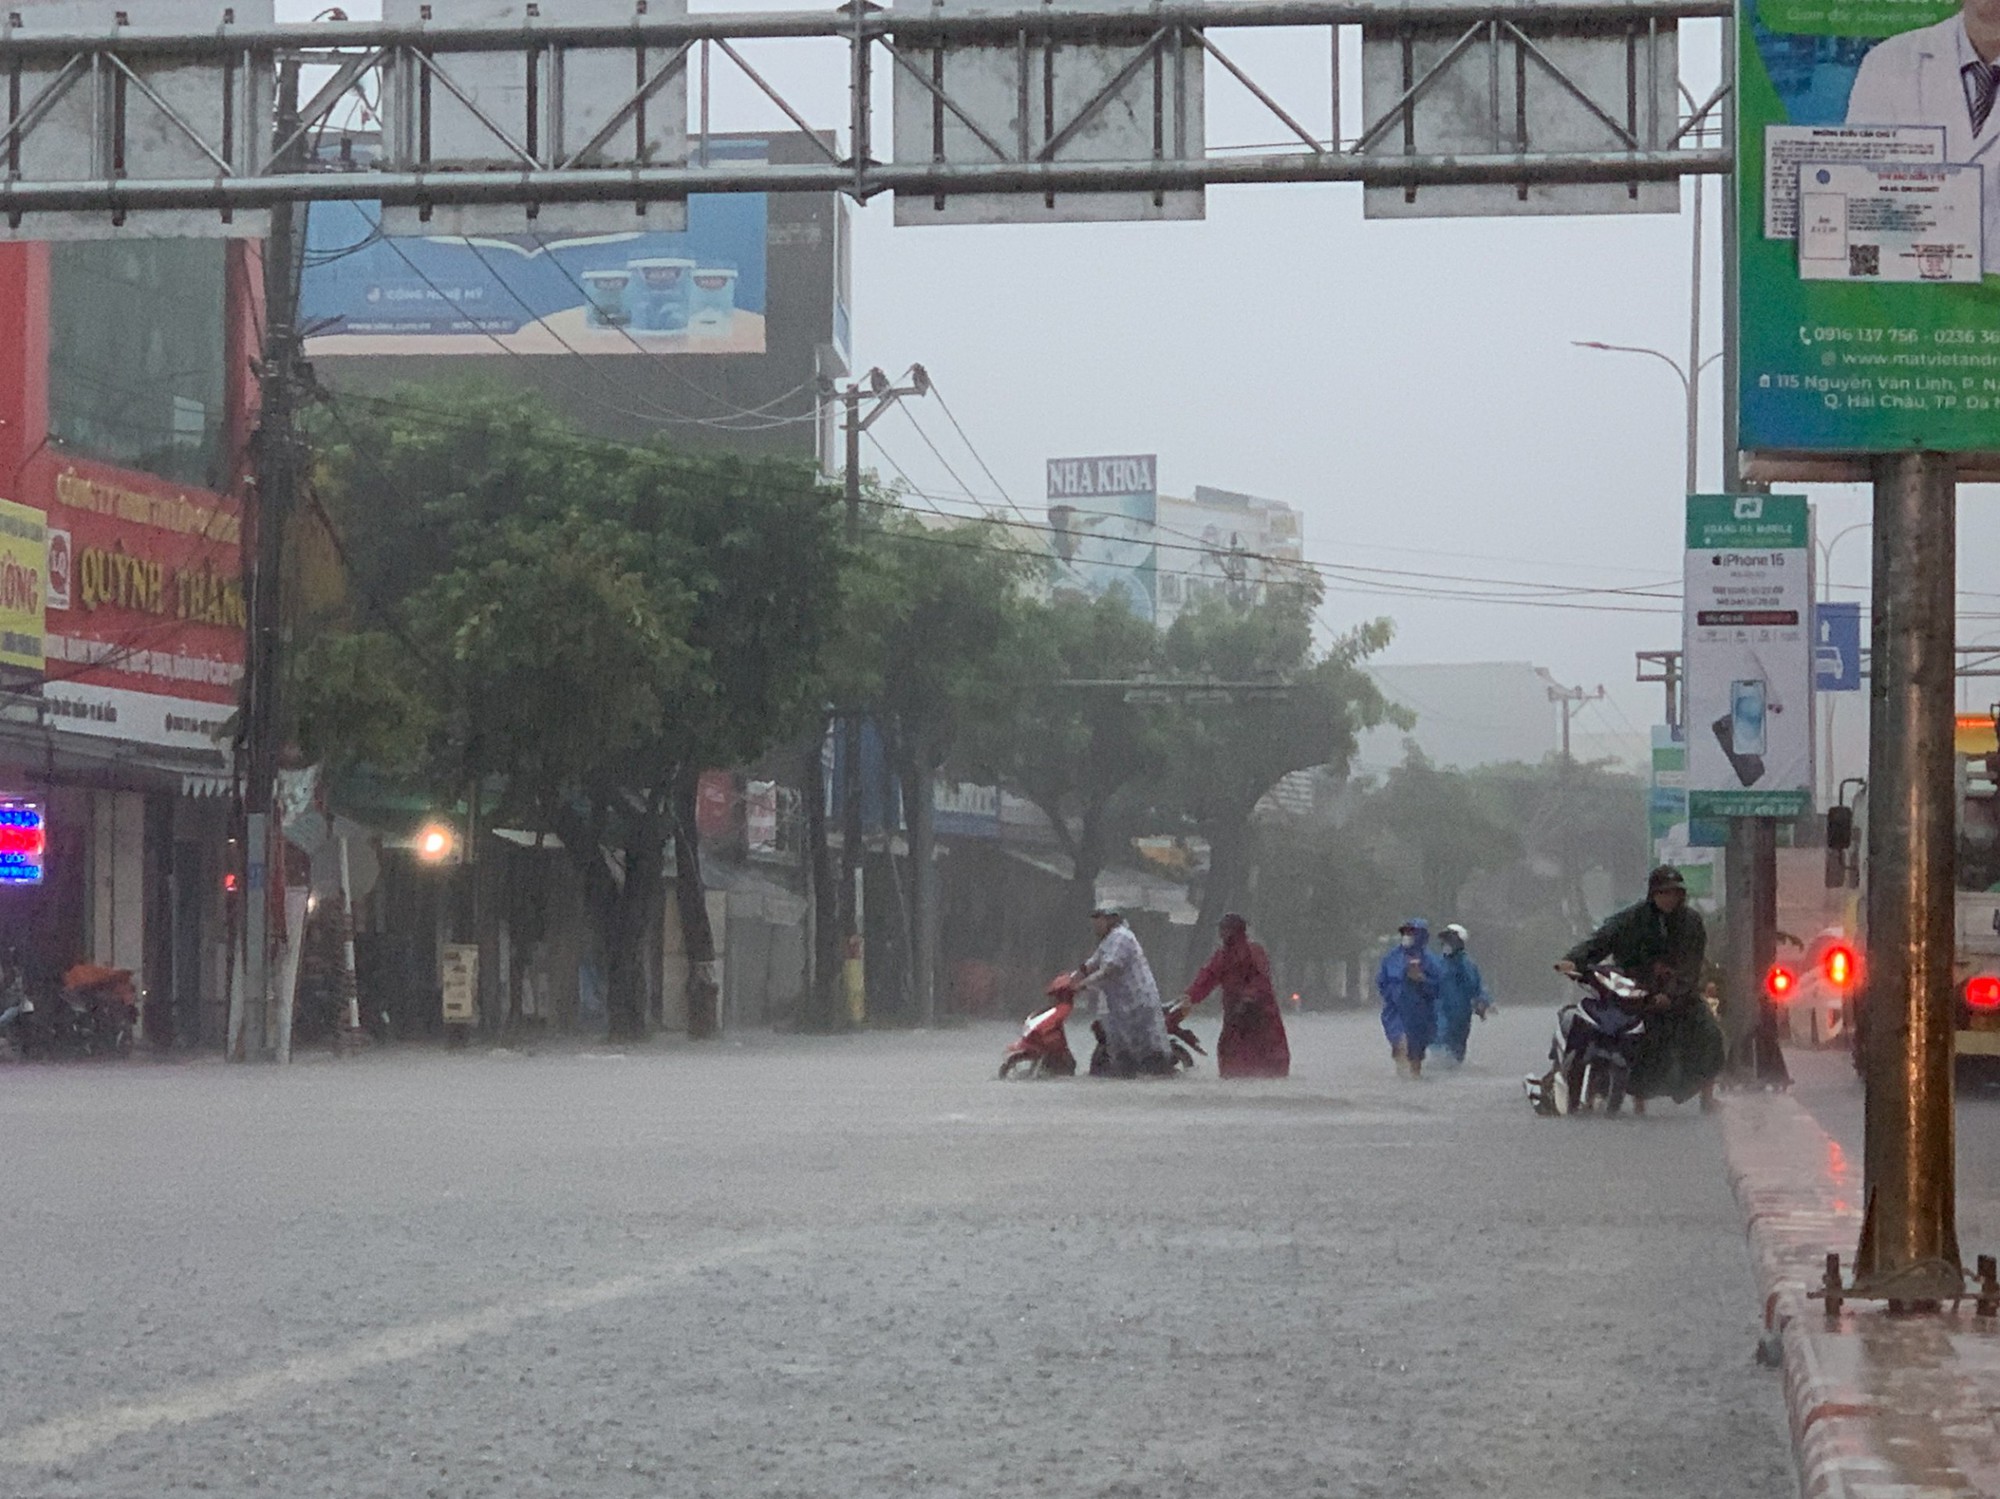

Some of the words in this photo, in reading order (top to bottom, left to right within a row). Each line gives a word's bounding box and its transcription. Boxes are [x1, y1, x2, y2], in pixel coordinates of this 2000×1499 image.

[1814, 327, 1852, 342] 0916
[1858, 327, 1883, 342] 137
[1886, 328, 1918, 342] 756
[1934, 329, 1975, 343] 0236
[1778, 375, 1799, 388] 115
[1983, 377, 2000, 390] N
[1048, 461, 1093, 494] NHA
[1098, 458, 1153, 492] KHOA
[1723, 553, 1768, 567] iPhone
[81, 538, 163, 614] QUỲNH
